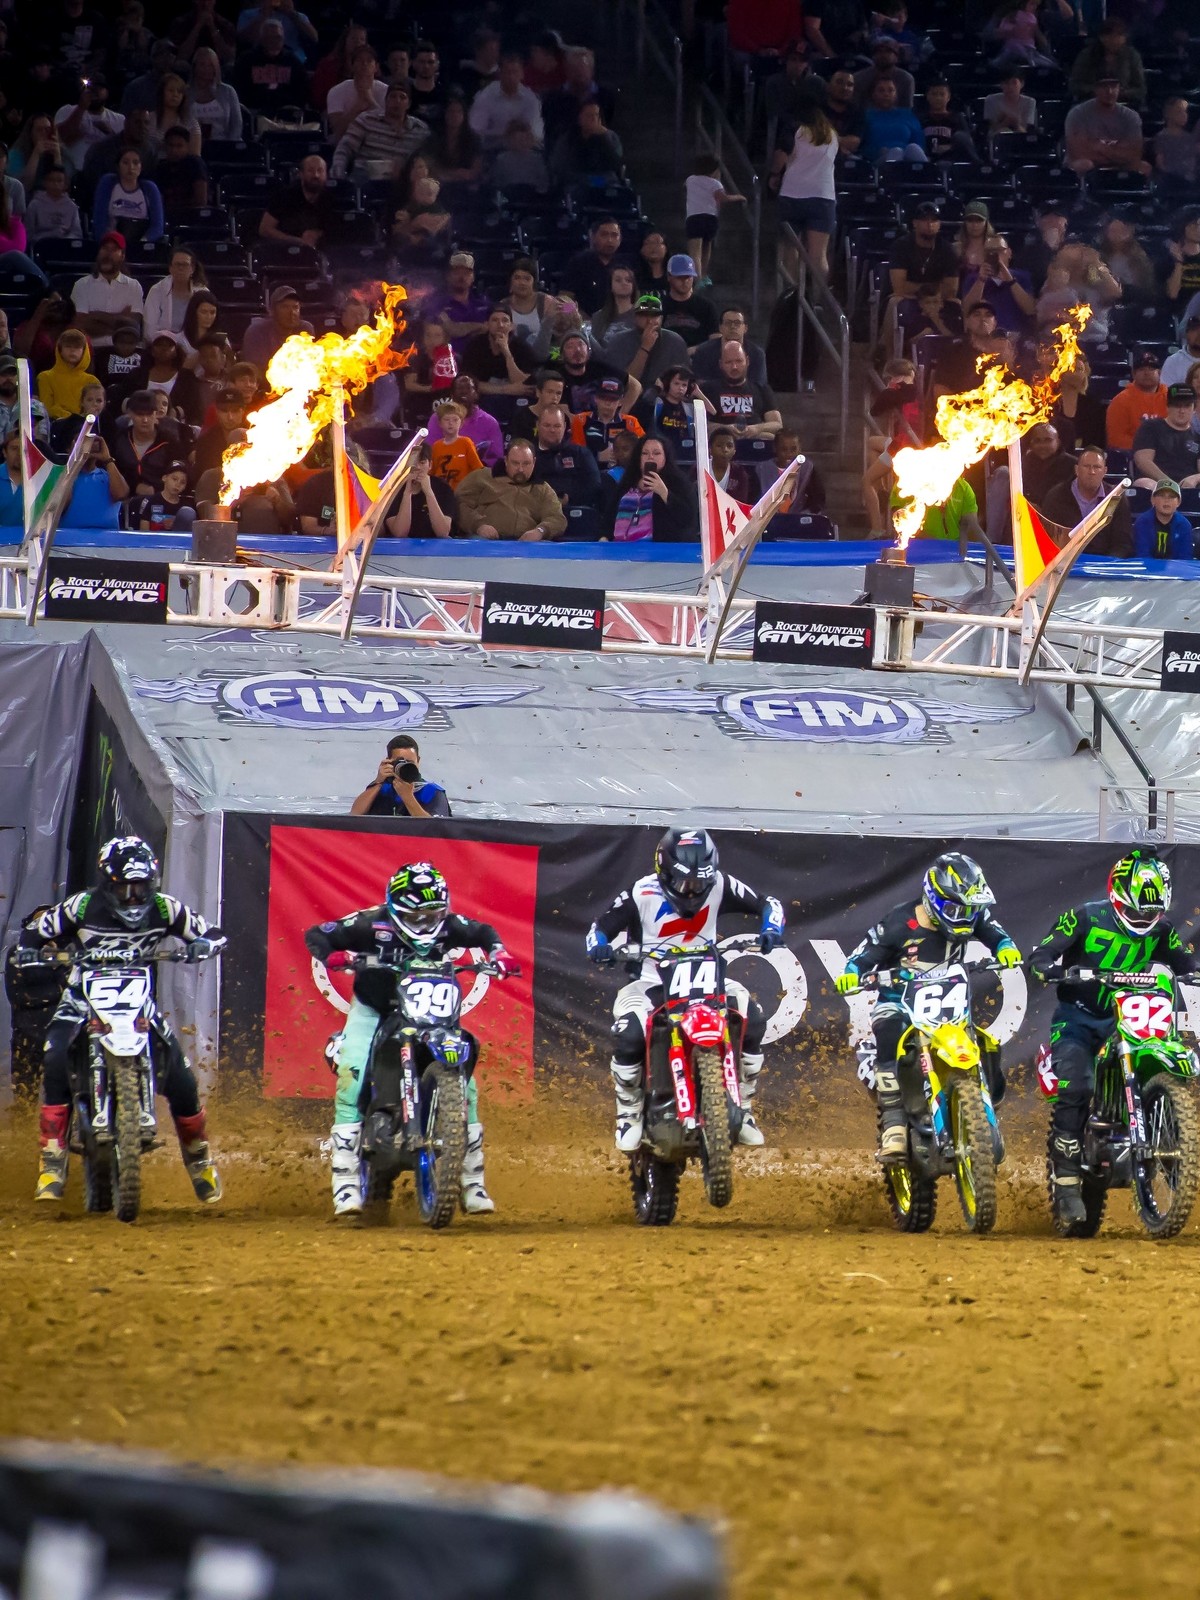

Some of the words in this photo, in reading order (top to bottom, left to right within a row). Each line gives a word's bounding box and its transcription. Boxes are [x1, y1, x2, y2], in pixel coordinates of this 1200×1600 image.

[720, 396, 753, 406] RUN
[723, 404, 752, 414] VIP
[67, 577, 102, 587] ROCKY
[103, 578, 159, 590] MOUNTAIN
[504, 602, 538, 612] ROCKY
[539, 605, 595, 617] MOUNTAIN
[775, 621, 808, 631] ROCKY
[810, 624, 865, 635] MOUNTAIN
[253, 687, 400, 714] FIM
[750, 699, 898, 728] FIM
[669, 960, 717, 997] 44
[89, 978, 147, 1010] 54
[407, 981, 459, 1018] 39
[914, 983, 968, 1019] 64
[1121, 995, 1173, 1033] 92
[671, 1058, 691, 1113] GICO
